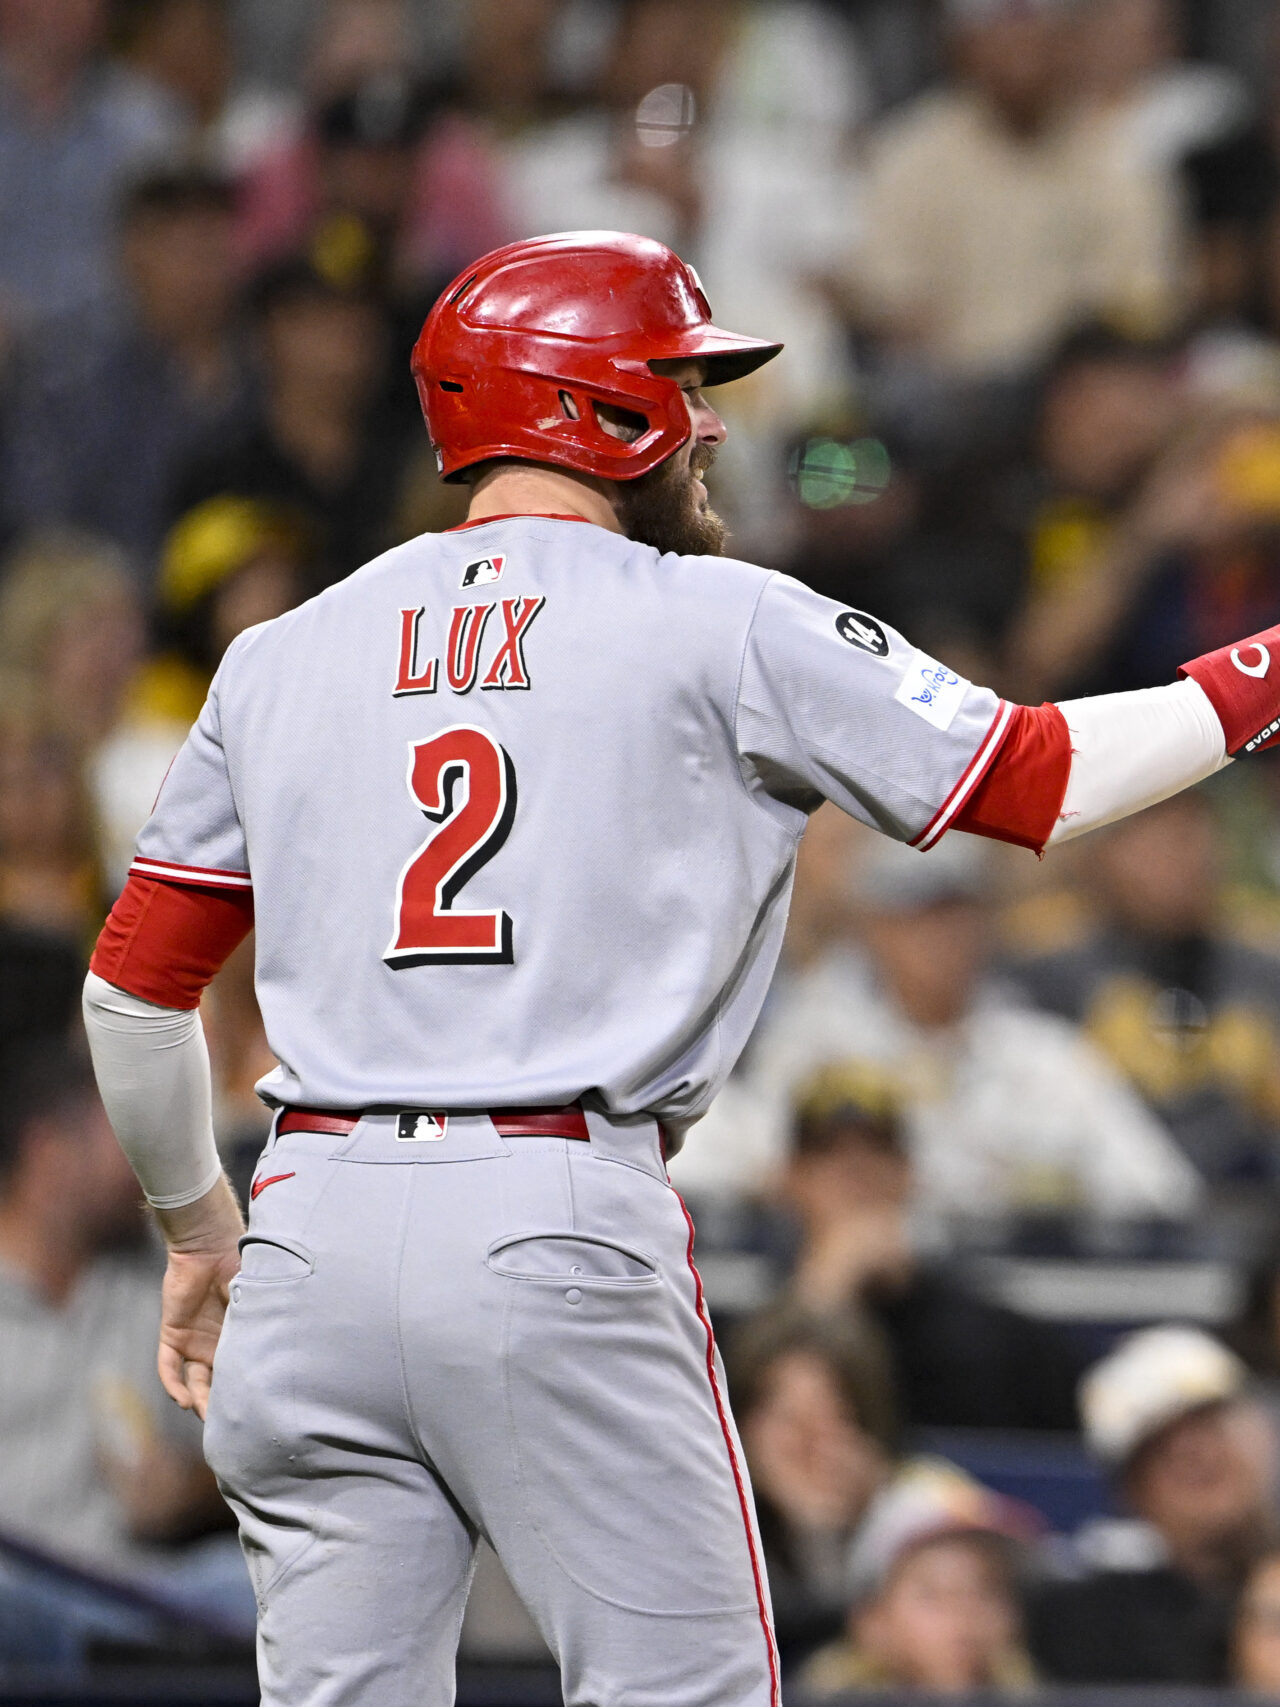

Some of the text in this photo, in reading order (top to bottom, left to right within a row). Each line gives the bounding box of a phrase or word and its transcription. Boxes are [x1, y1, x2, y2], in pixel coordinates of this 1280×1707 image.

[392, 595, 546, 697] LUX
[843, 617, 883, 652] 14
[921, 666, 959, 693] Krog
[382, 723, 517, 970] 2
